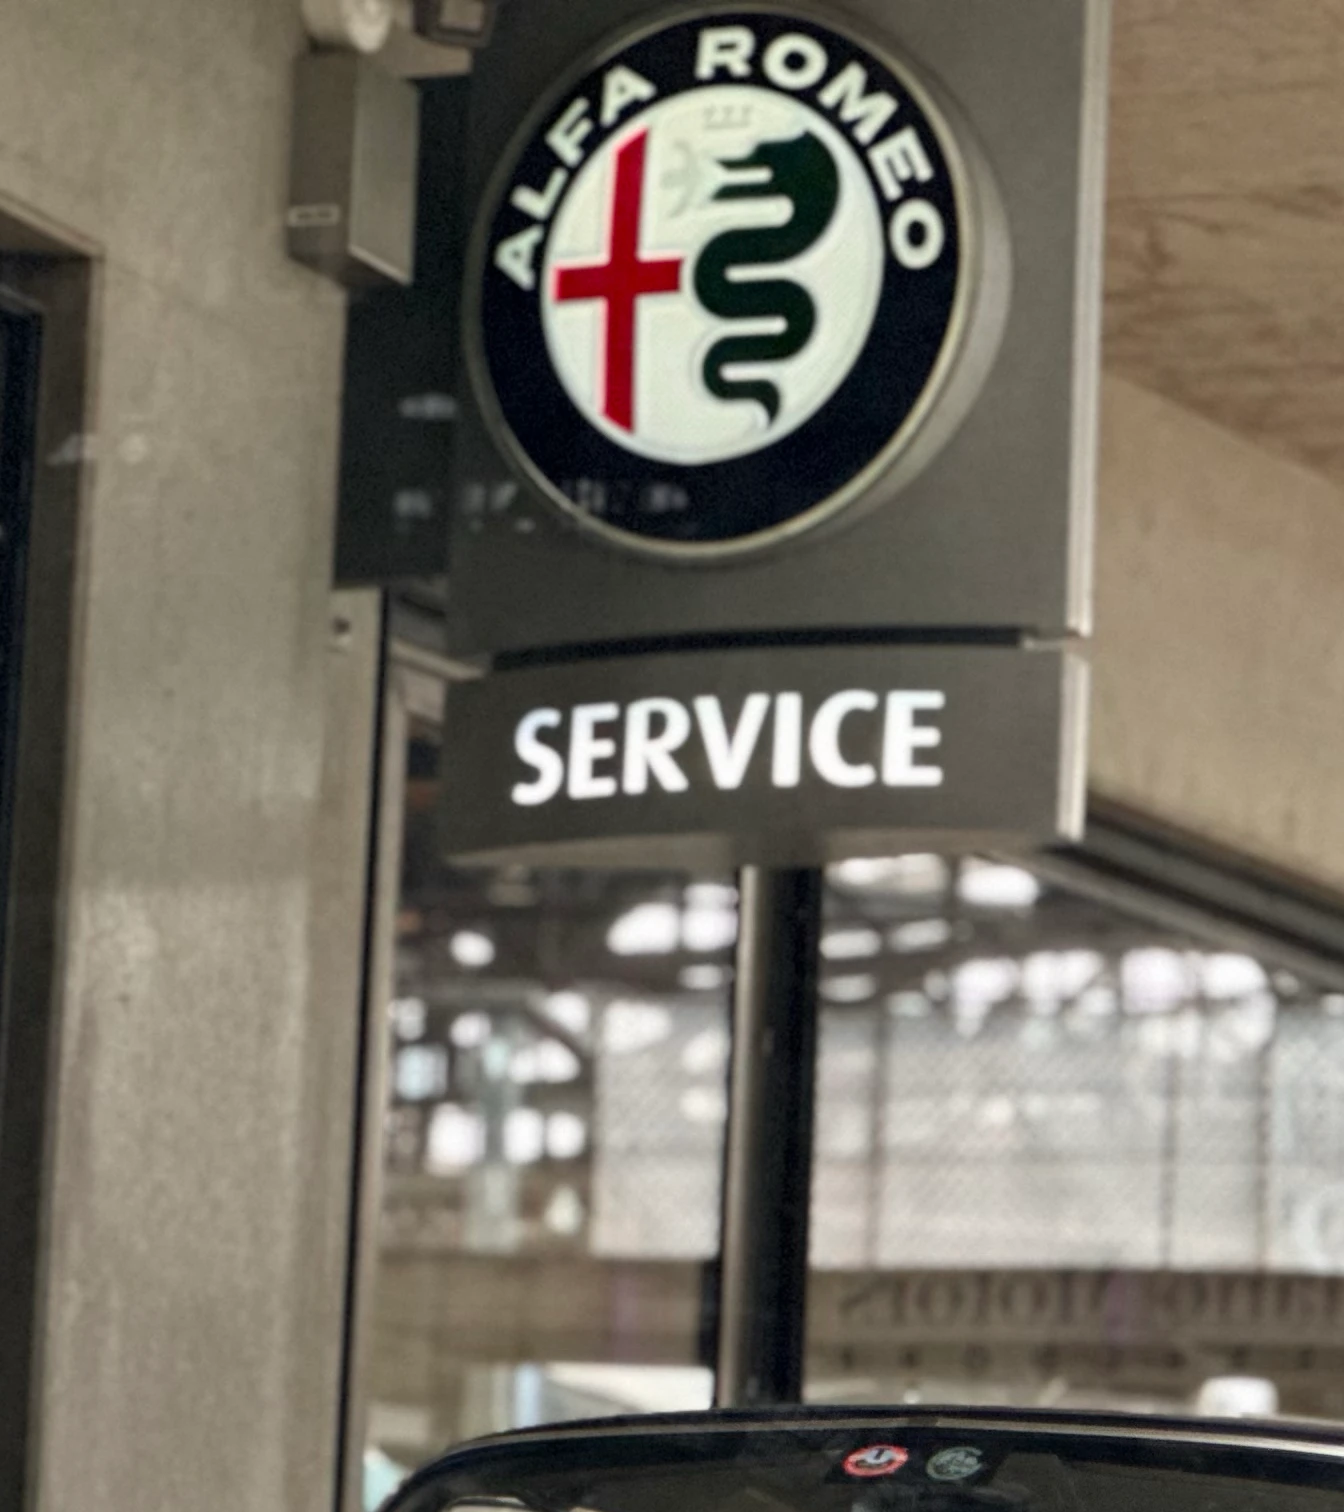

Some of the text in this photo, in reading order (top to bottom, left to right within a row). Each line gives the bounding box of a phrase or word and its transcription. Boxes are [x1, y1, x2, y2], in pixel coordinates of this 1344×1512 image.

[494, 25, 945, 291] ALFA ROMEO
[511, 689, 945, 806] SERVICE
